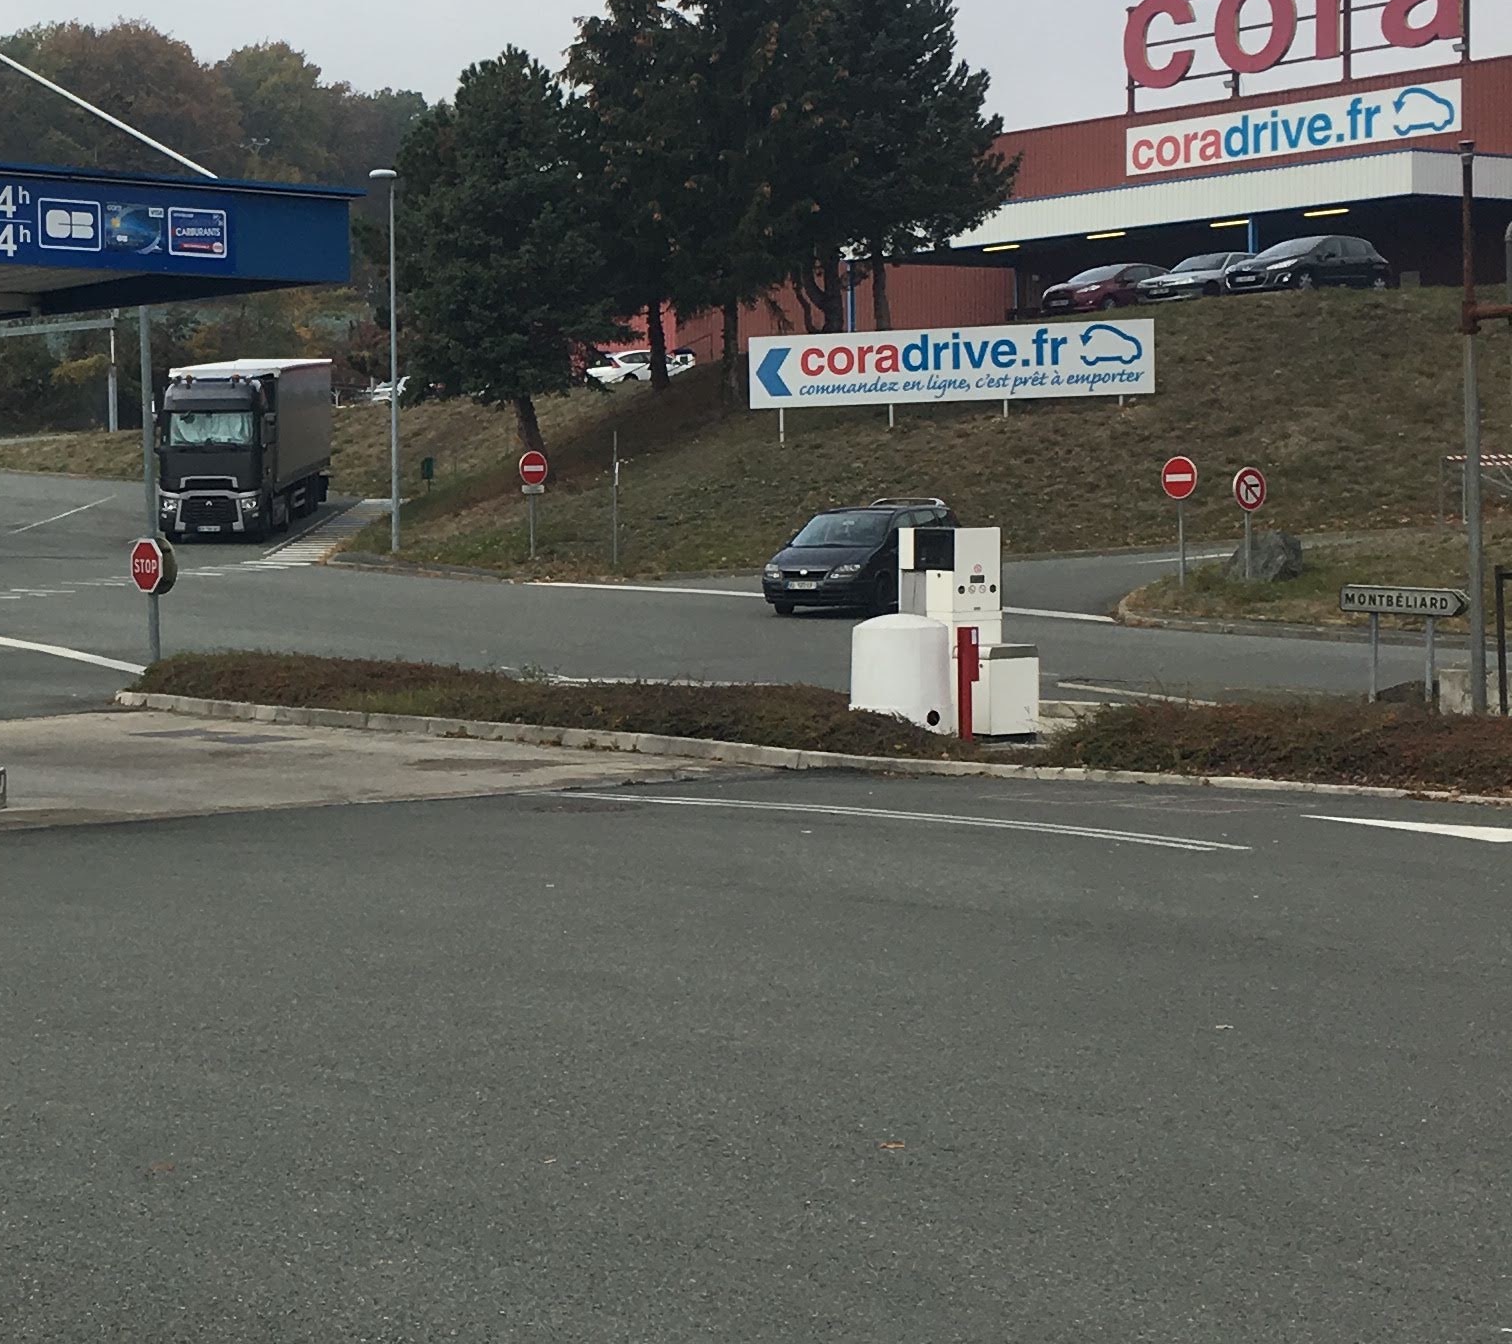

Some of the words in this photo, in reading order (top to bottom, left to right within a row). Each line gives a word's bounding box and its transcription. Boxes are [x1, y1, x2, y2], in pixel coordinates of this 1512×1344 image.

[1131, 97, 1381, 171] coradrive.fr
[175, 227, 221, 237] CARBURANTS
[800, 327, 1068, 376] coradrive.fr
[799, 376, 899, 396] commandez
[903, 380, 924, 392] en
[926, 374, 970, 398] ligne,
[975, 373, 1013, 389] c'est
[1010, 371, 1048, 395] prêt
[1051, 370, 1063, 386] à
[1066, 369, 1144, 392] emporter
[134, 558, 158, 574] STOP
[1344, 592, 1448, 610] MONTBÉLIARD
